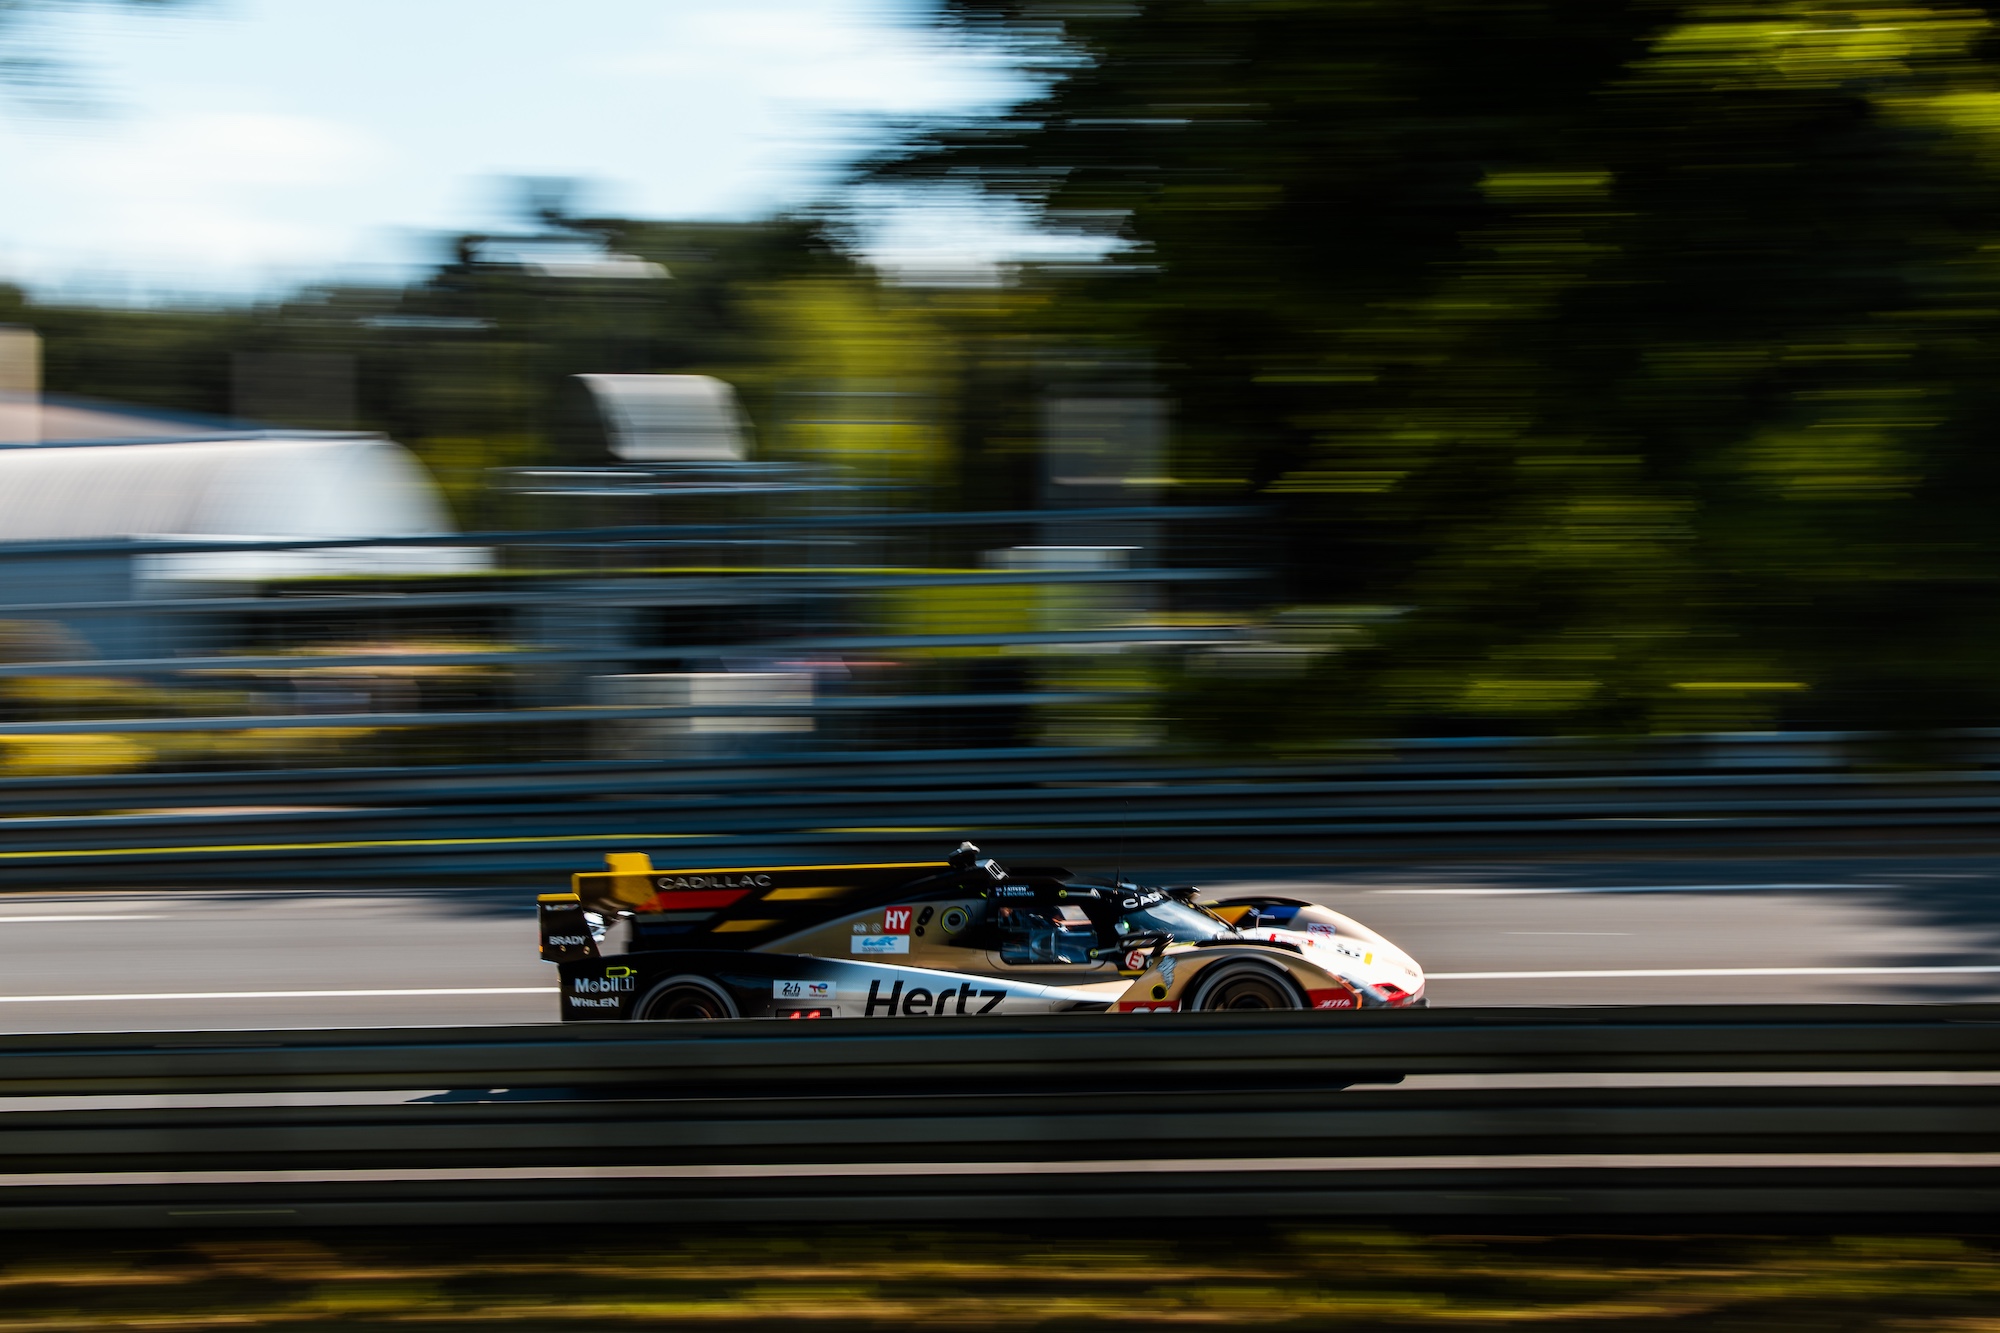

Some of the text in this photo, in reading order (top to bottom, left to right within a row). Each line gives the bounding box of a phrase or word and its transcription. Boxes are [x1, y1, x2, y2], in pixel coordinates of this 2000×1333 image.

[657, 874, 771, 890] CADILLAC
[885, 910, 910, 929] HY
[549, 935, 585, 945] BRADY
[575, 976, 619, 993] Mobil
[569, 996, 619, 1007] WHELEN
[864, 979, 1007, 1017] Hertz
